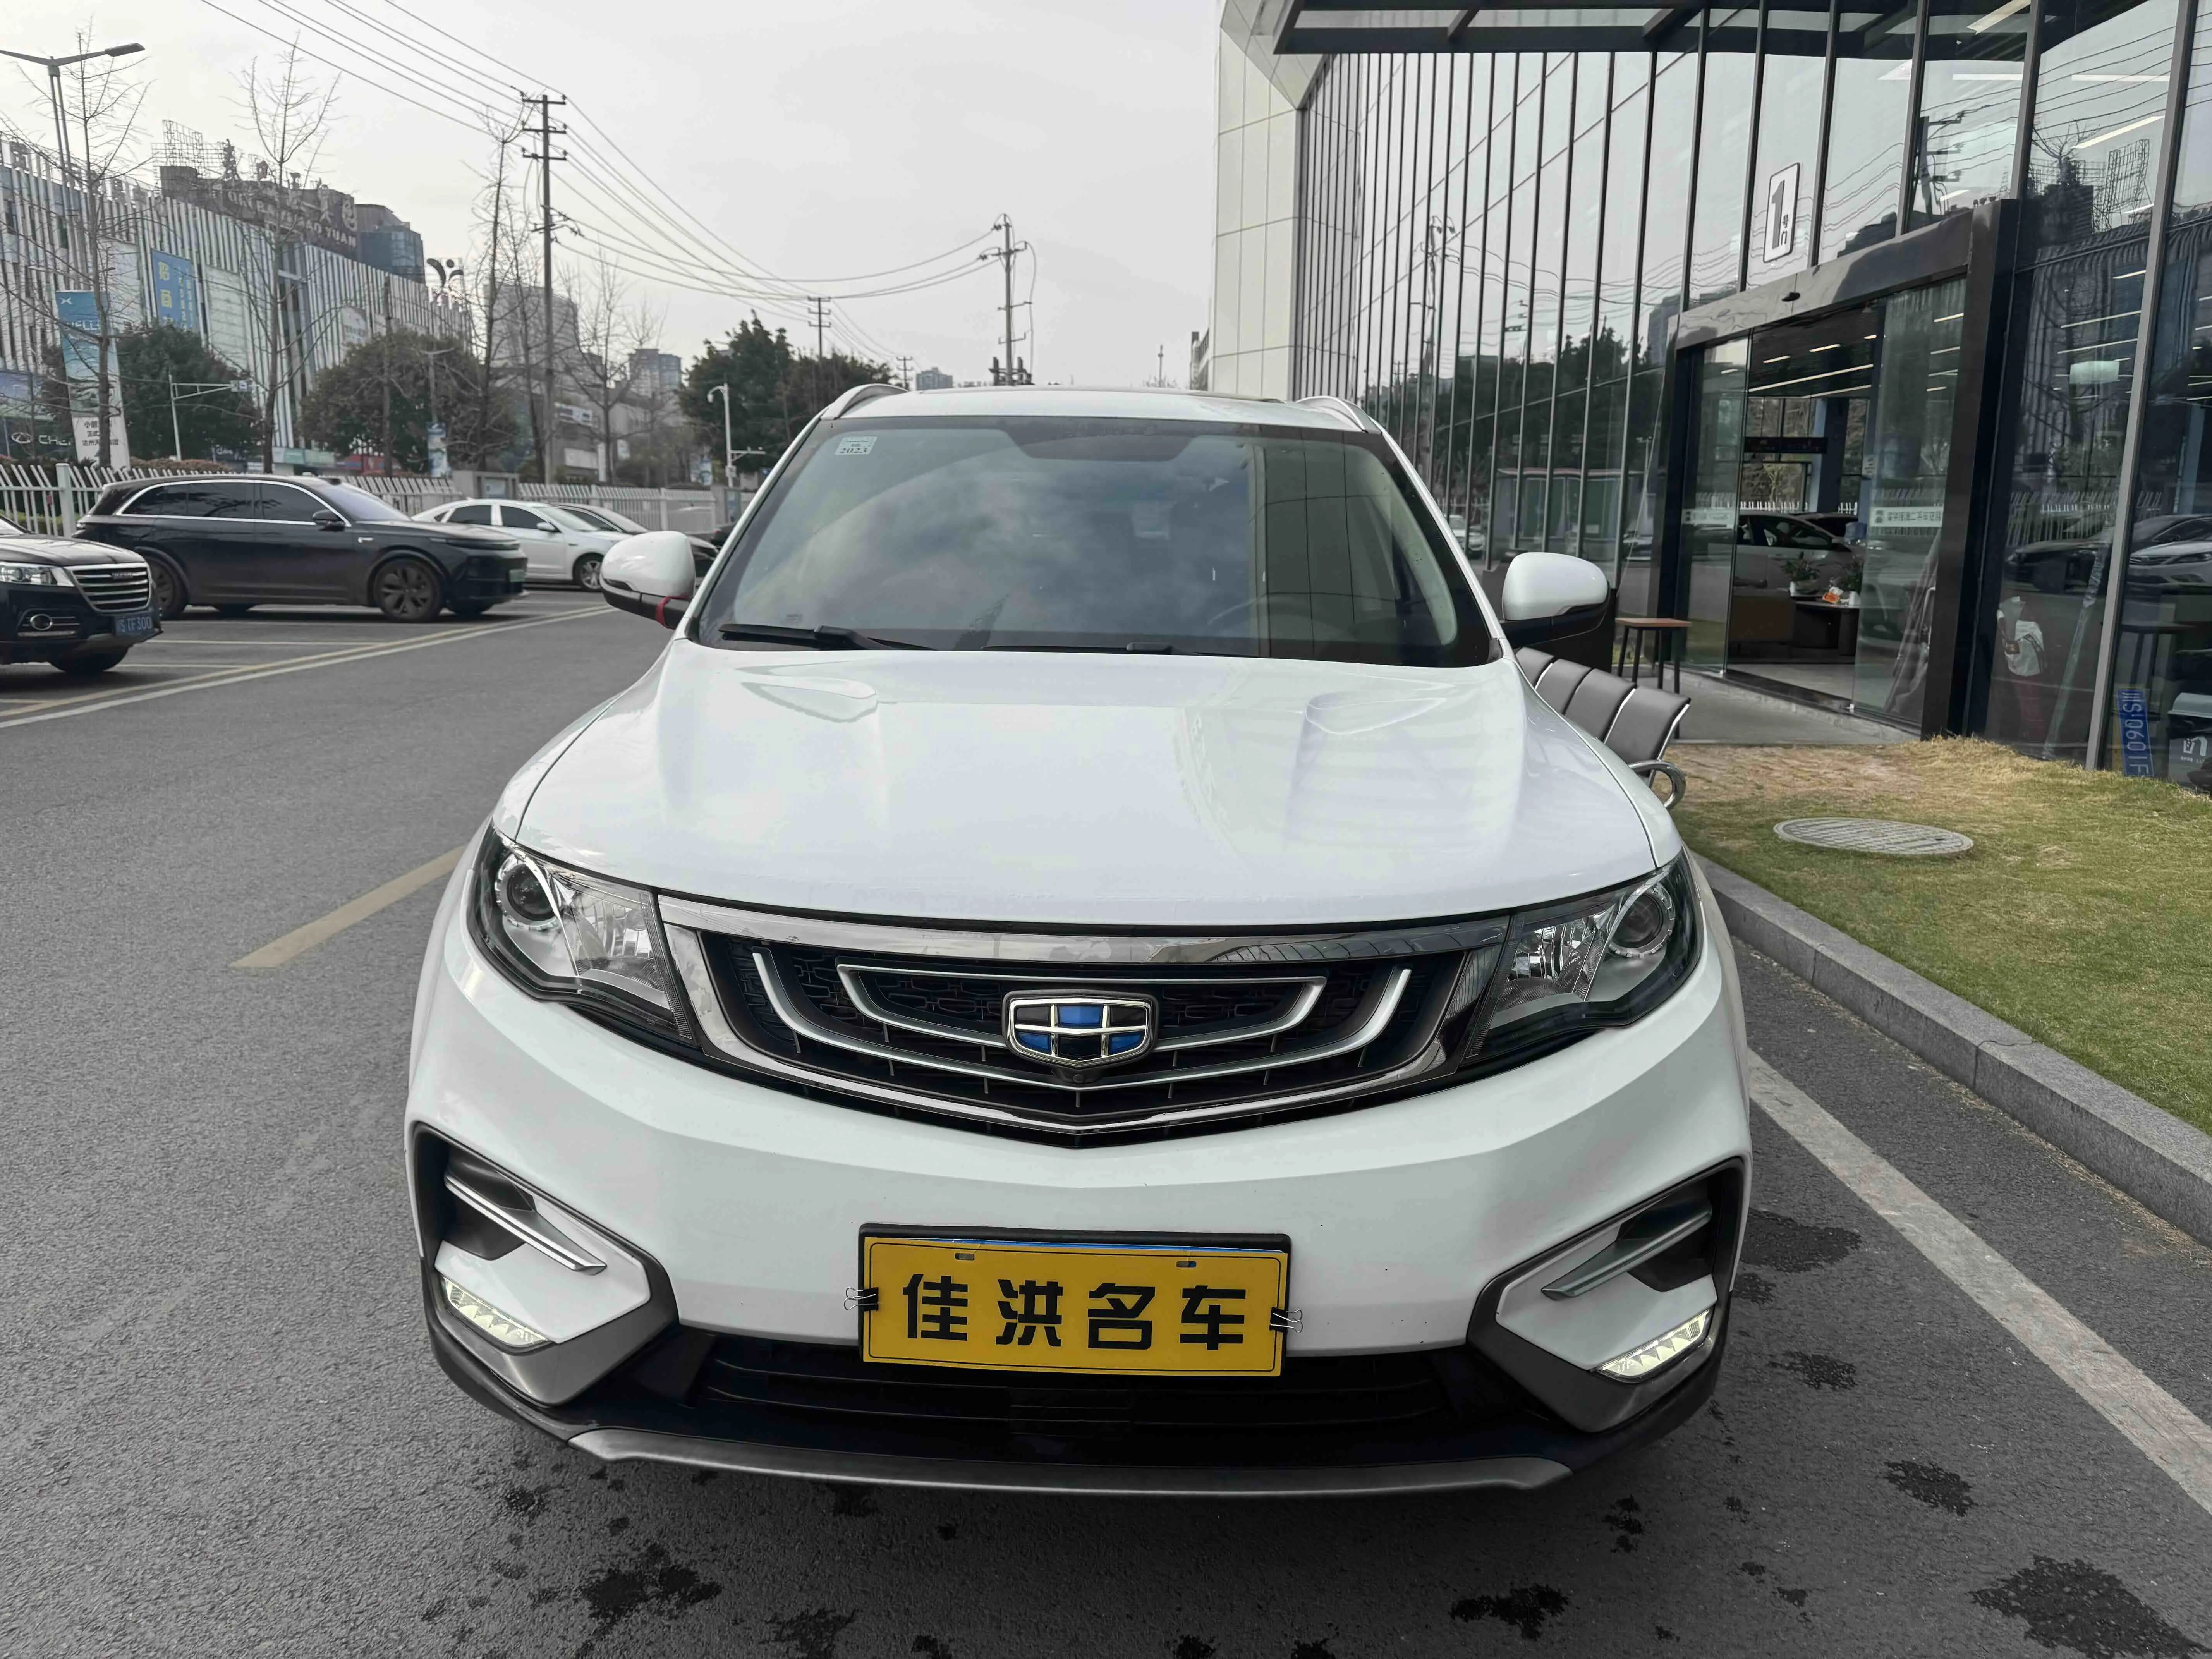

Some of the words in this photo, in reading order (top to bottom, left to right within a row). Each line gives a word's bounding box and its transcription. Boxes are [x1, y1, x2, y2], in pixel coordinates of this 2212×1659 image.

[325, 226, 356, 248] YUAN
[903, 1273, 1246, 1351] 佳洪名车
